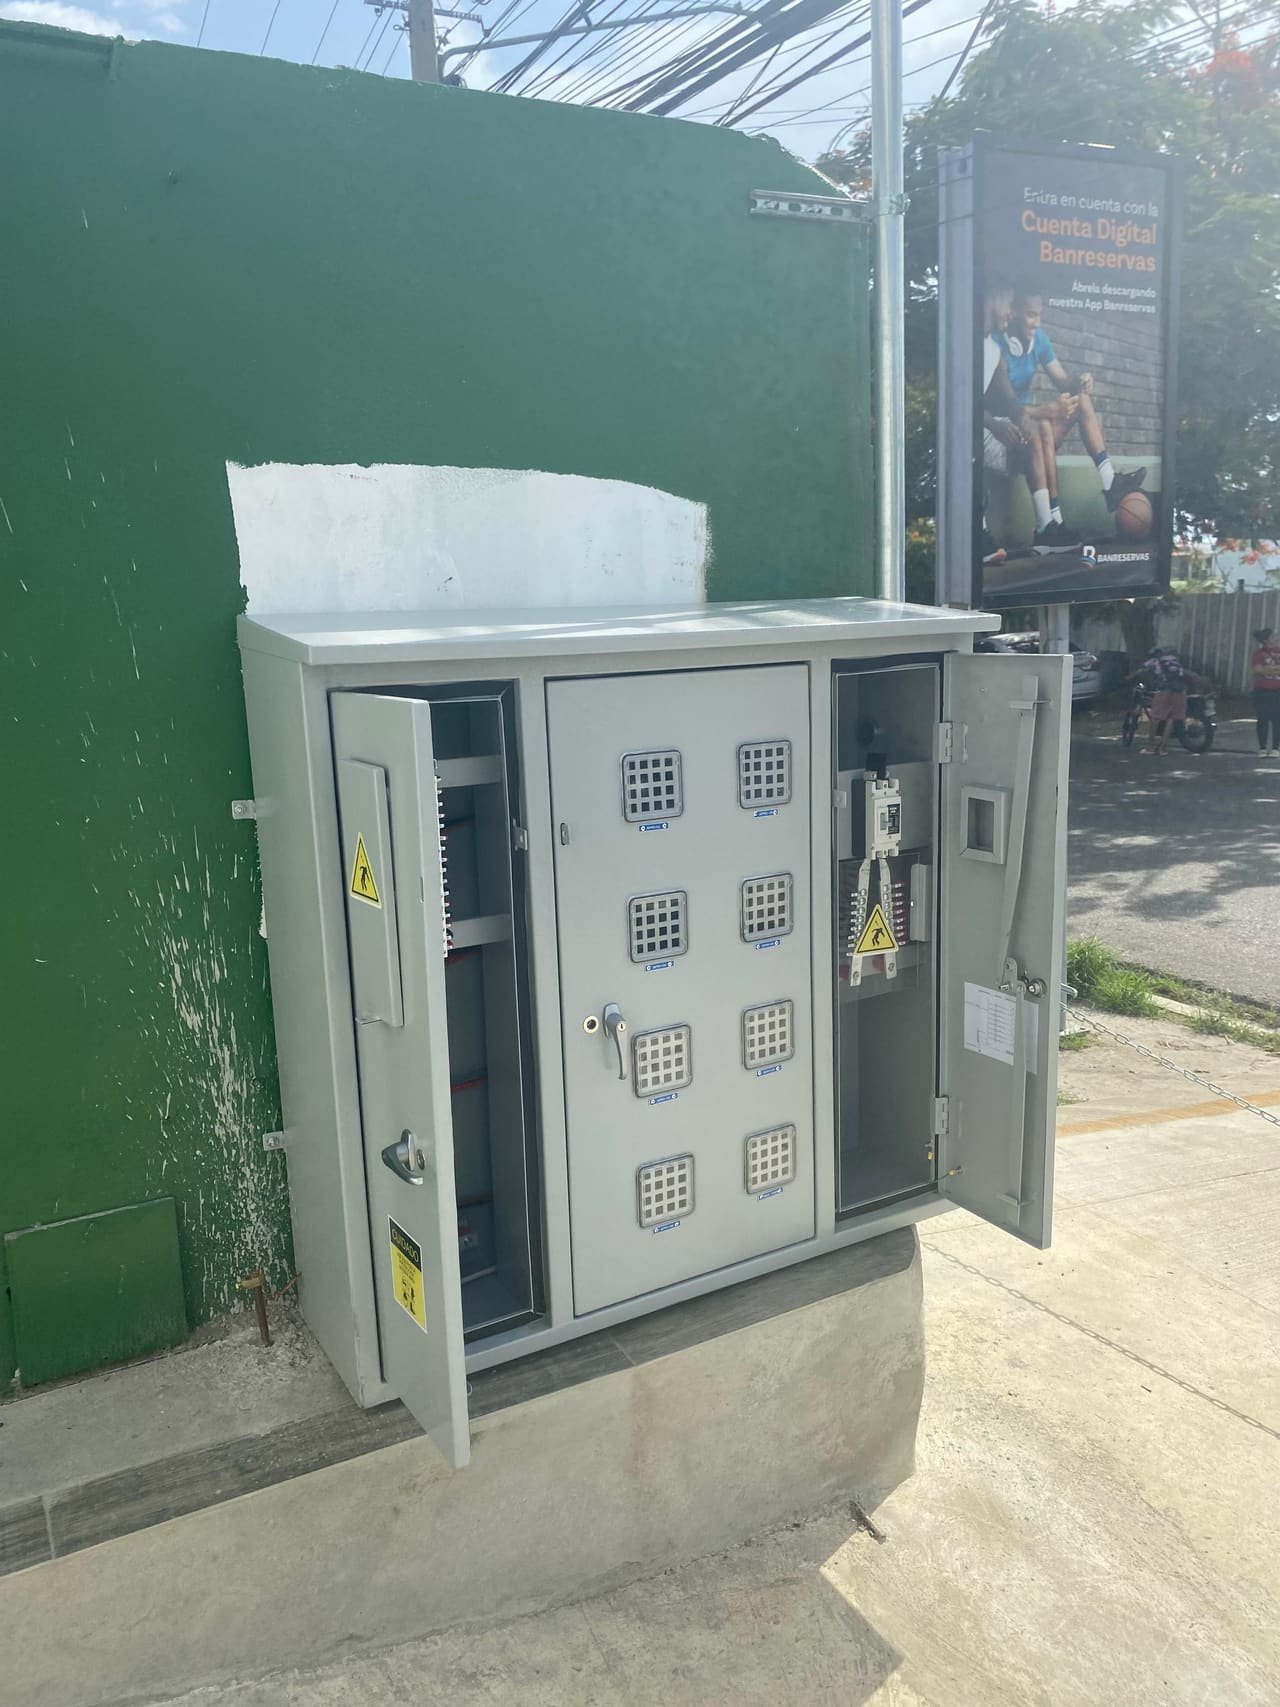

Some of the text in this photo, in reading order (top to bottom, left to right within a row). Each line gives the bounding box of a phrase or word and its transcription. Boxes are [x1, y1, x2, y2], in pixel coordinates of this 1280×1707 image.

[1060, 195, 1076, 208] en
[1078, 197, 1121, 212] cuenta
[1123, 202, 1146, 215] con
[1148, 201, 1159, 217] la
[1021, 209, 1157, 247] Cuenta Digital
[1039, 240, 1157, 272] Banreservas
[1101, 283, 1157, 299] descargando
[1048, 297, 1156, 314] nuestra App Banreservas
[1097, 552, 1150, 562] BANRESERVAS
[391, 1228, 420, 1264] CUIDADO
